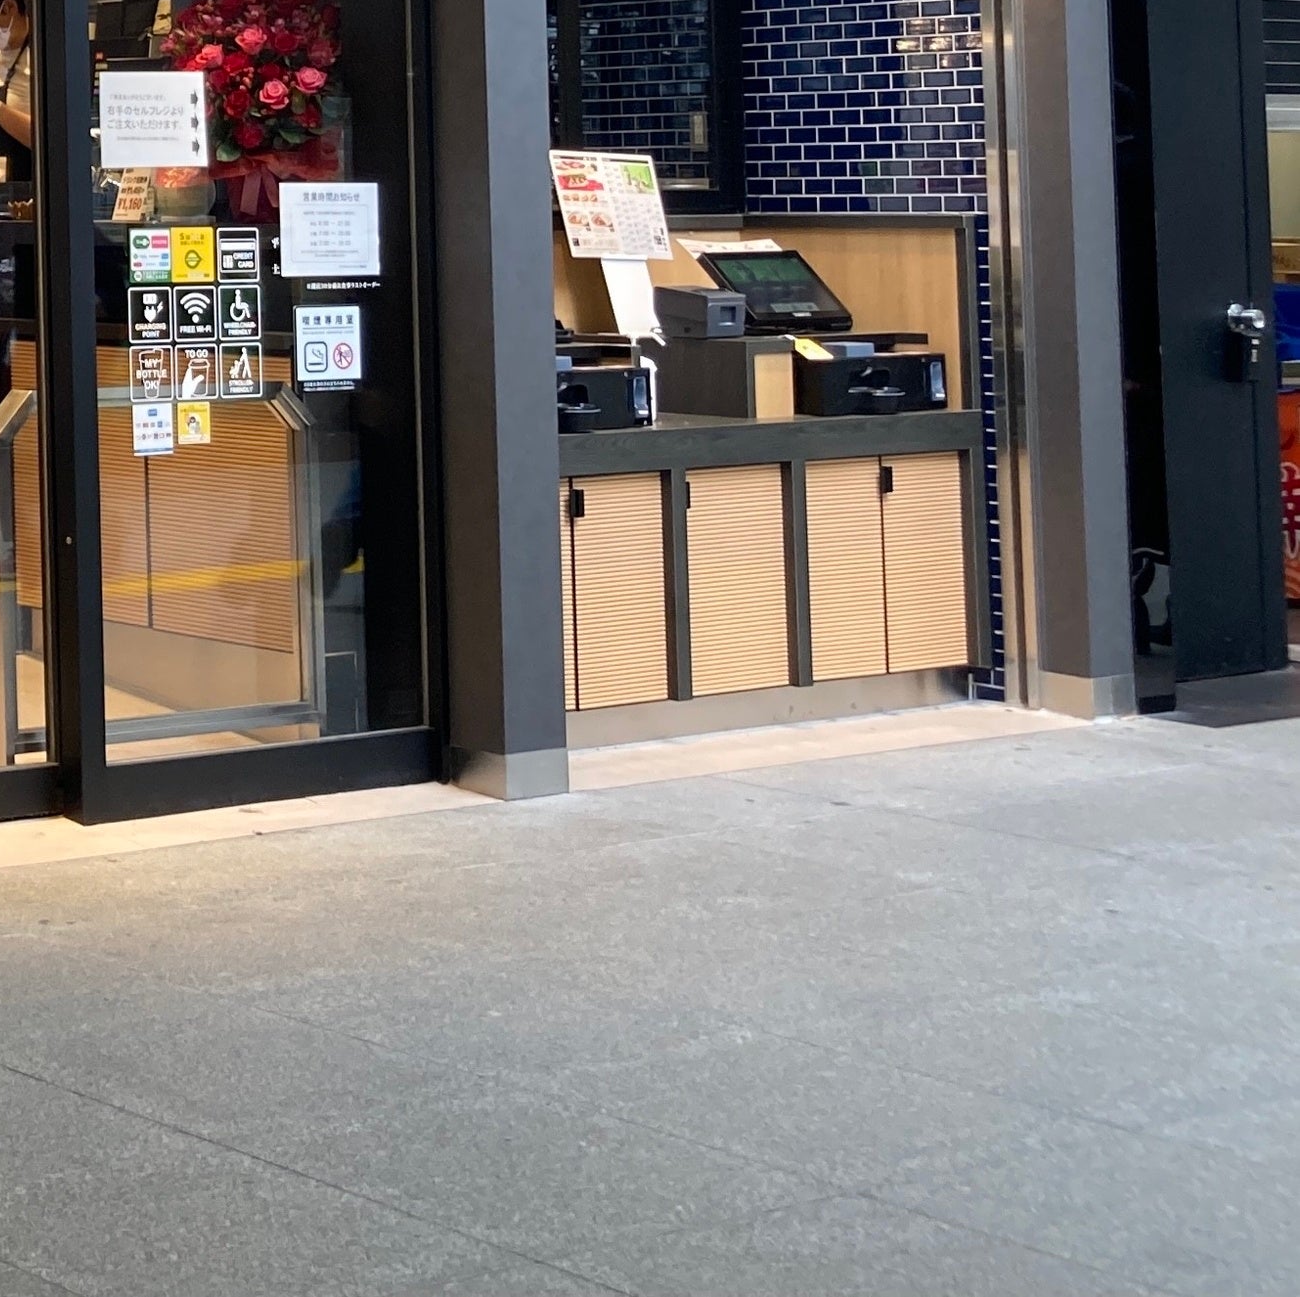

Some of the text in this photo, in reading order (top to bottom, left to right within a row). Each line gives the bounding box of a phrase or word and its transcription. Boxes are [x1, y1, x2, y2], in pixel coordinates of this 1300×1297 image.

[142, 330, 160, 338] POINT
[184, 349, 208, 358] TO GO
[144, 359, 158, 368] MY
[136, 369, 167, 379] BOTTLE
